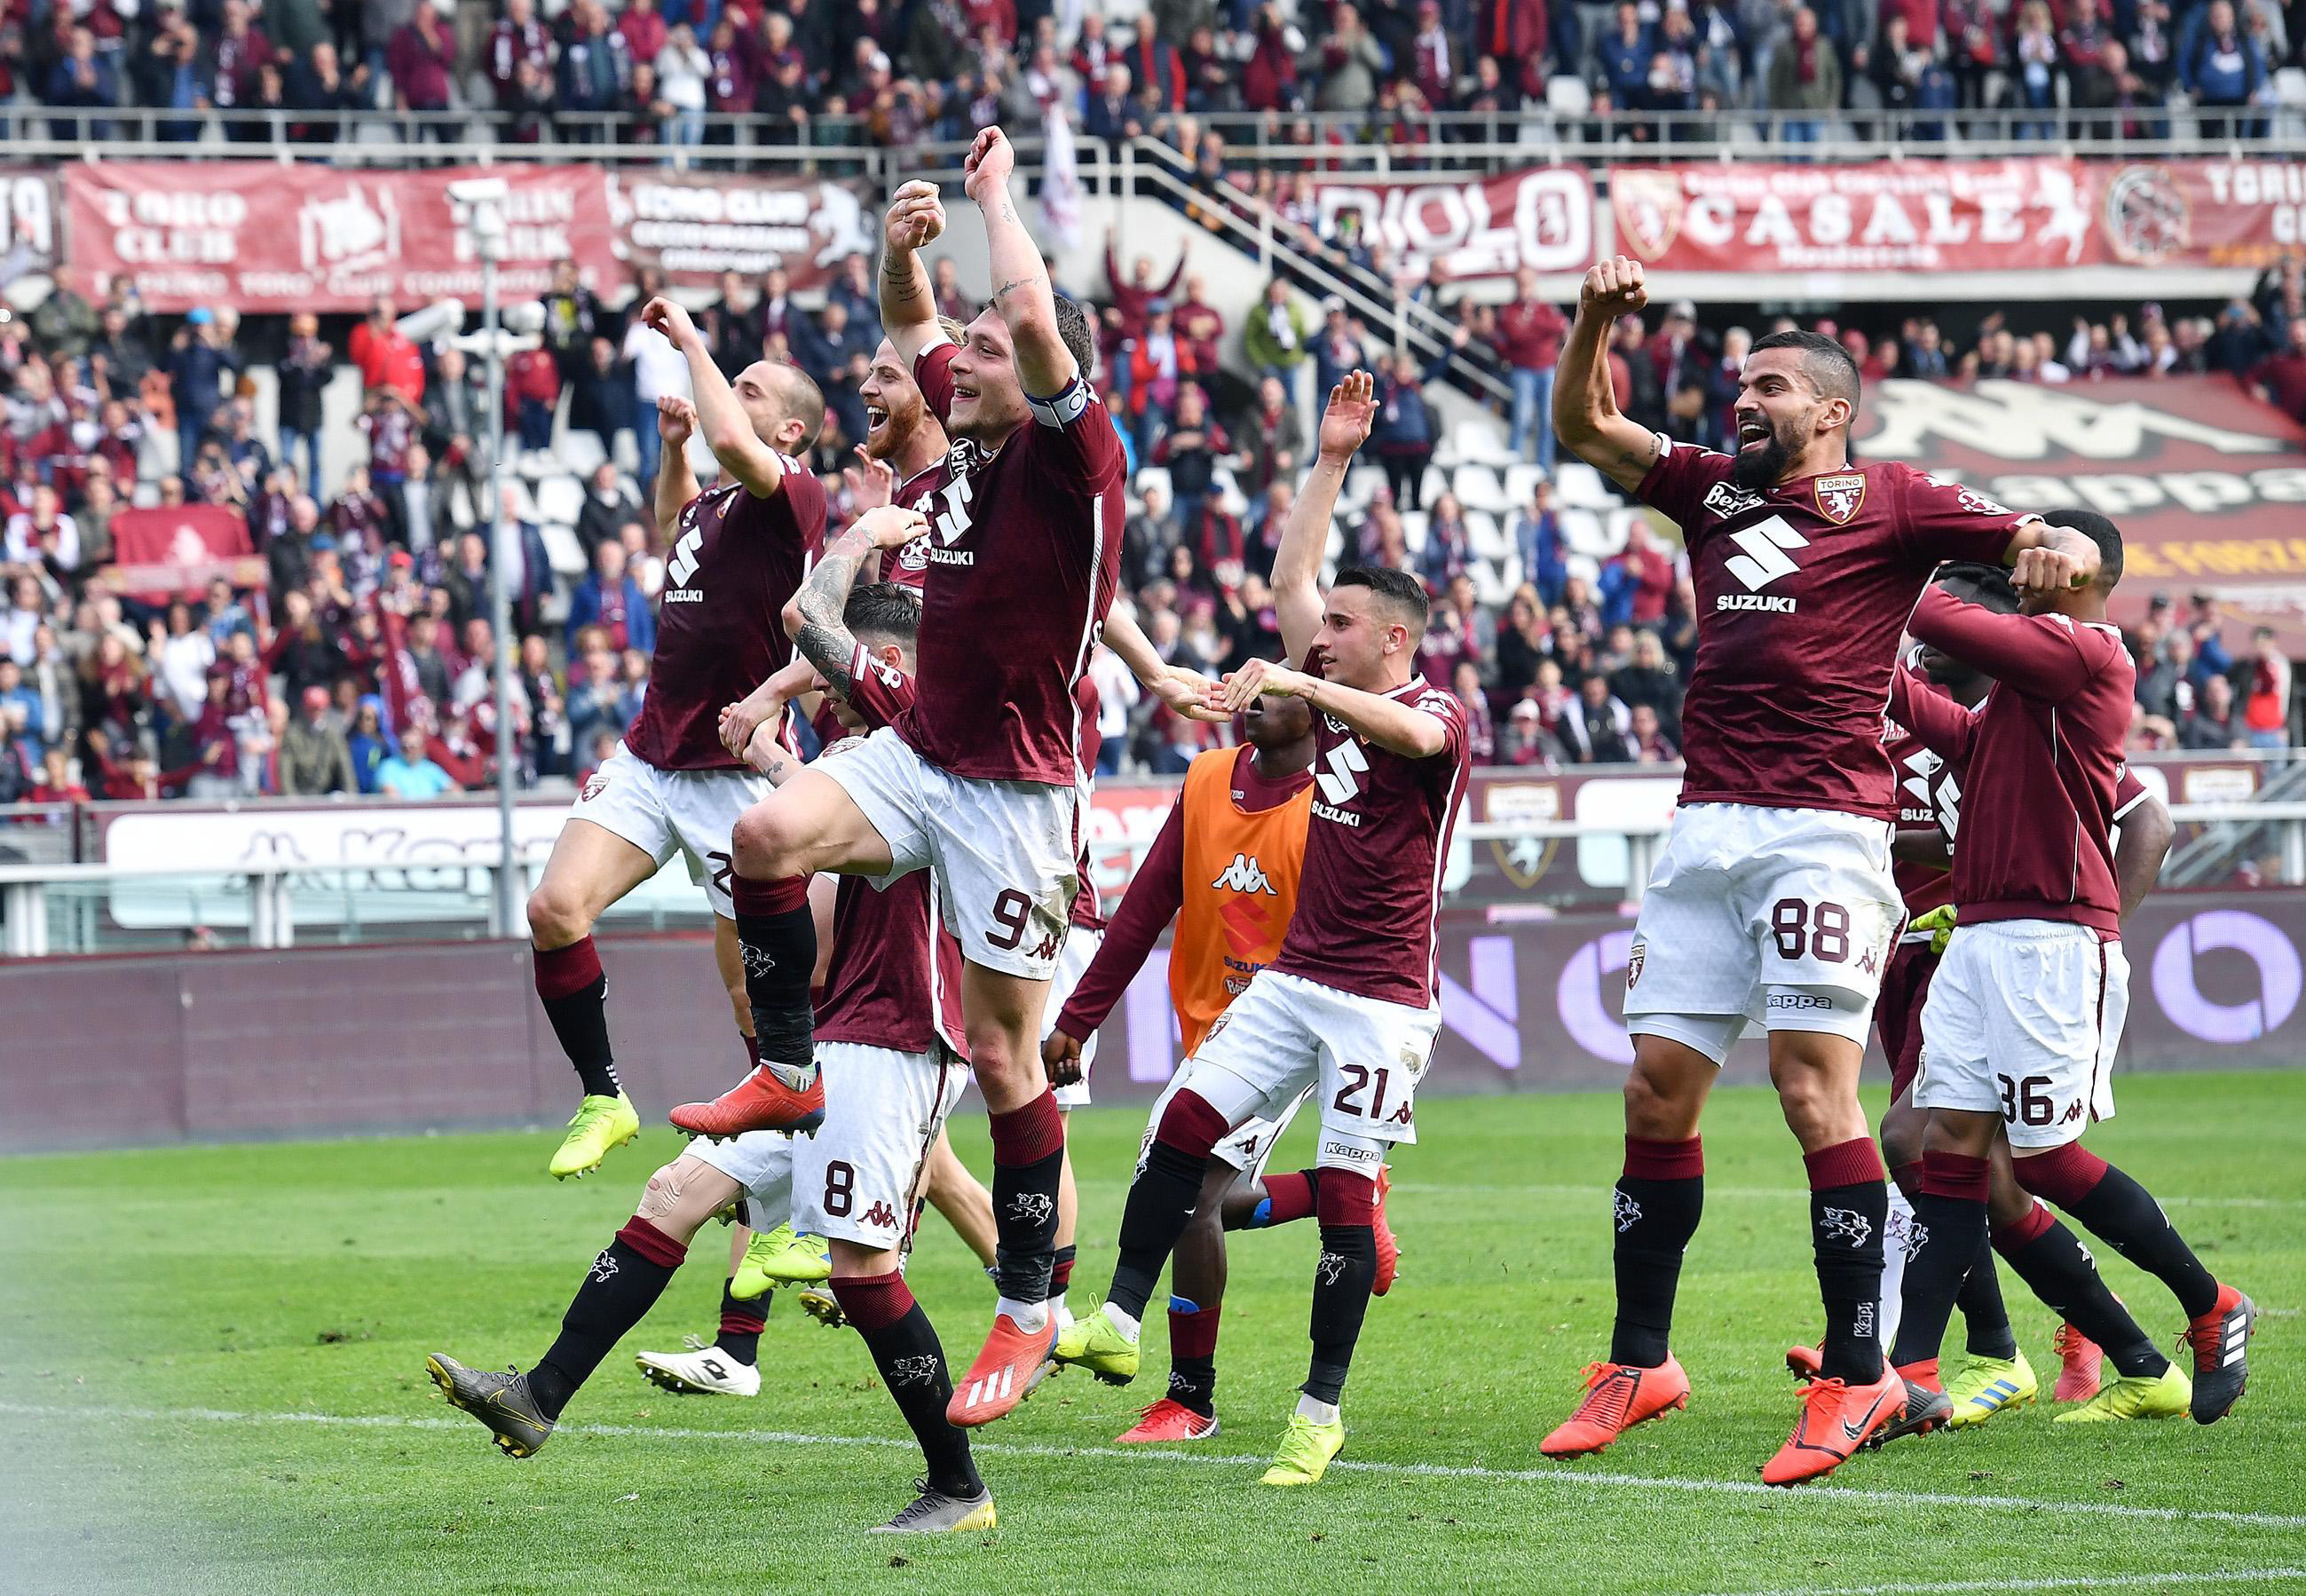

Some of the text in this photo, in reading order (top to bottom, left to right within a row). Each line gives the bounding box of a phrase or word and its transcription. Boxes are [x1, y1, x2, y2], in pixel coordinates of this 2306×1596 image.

[2206, 163, 2306, 205] TORI
[1687, 191, 2026, 245] CASALE
[1820, 478, 1860, 489] TORINO
[932, 548, 974, 565] SUZUKI
[665, 589, 703, 603] SUZUKI
[1717, 595, 1797, 613] SUZUKI
[1900, 808, 1935, 822] SUZ
[707, 850, 733, 898] 2
[984, 888, 1032, 951] 9
[1772, 897, 1850, 963] 88
[1224, 956, 1268, 973] SUZUK
[1333, 1063, 1389, 1119] 21
[1324, 1142, 1381, 1162] Kappa
[823, 1159, 855, 1218] 8
